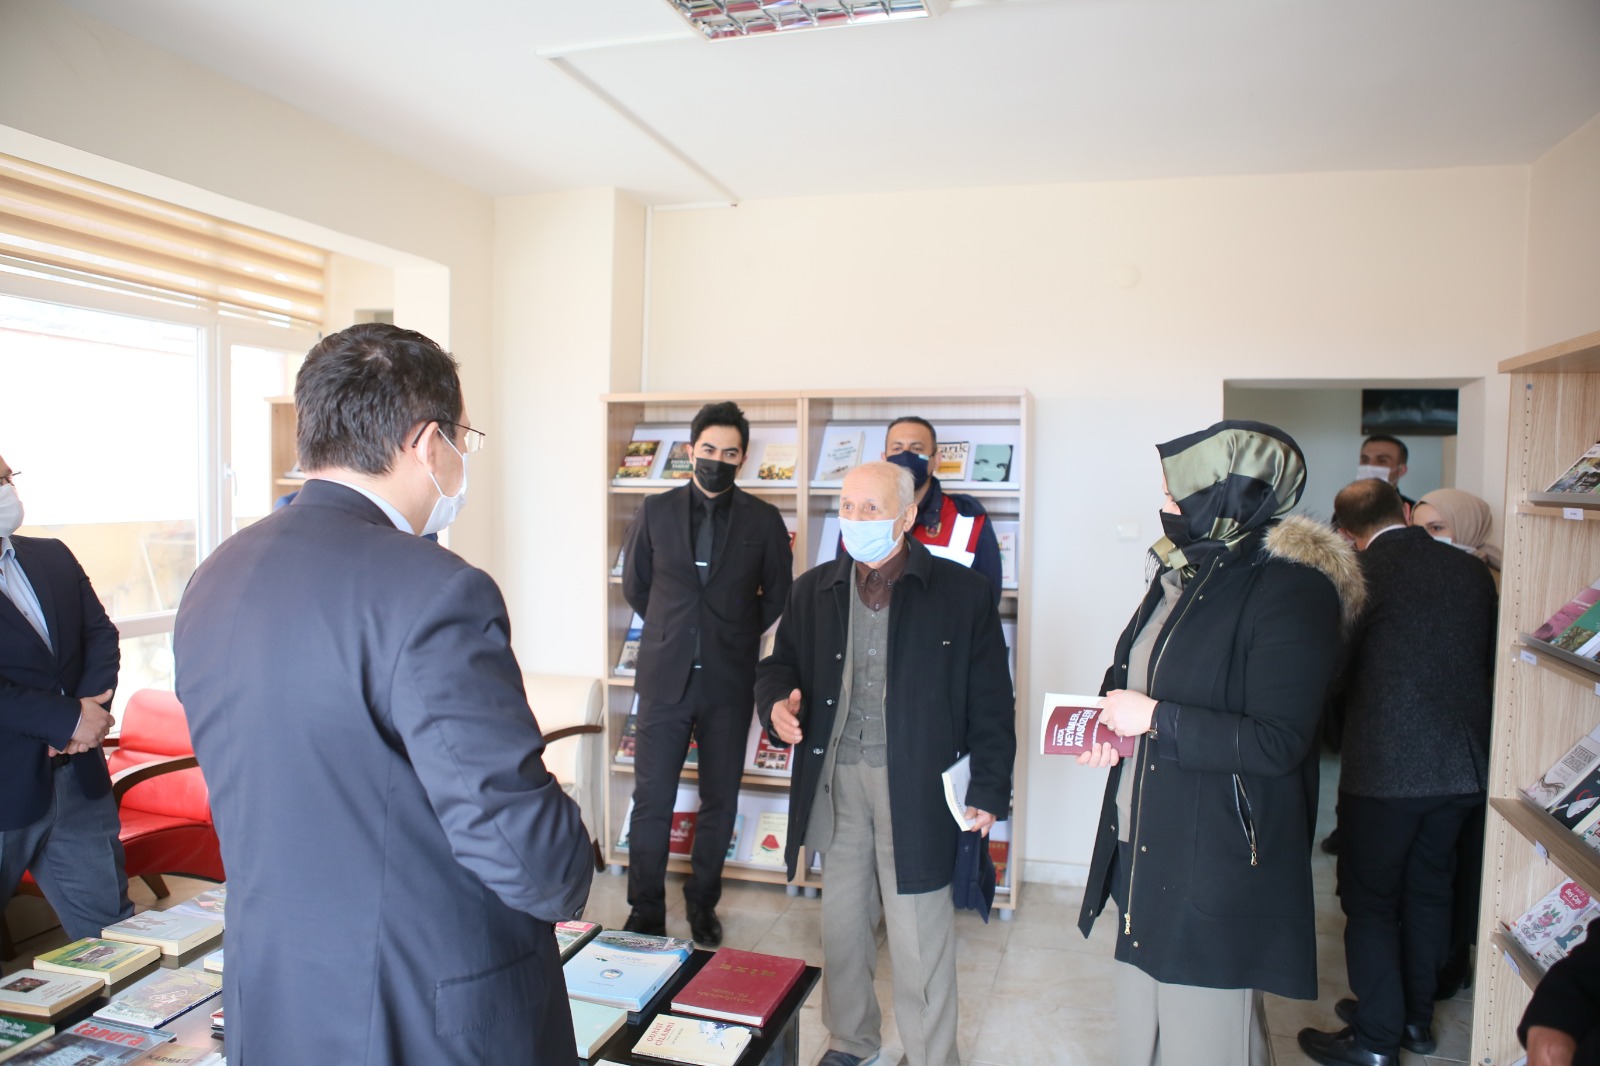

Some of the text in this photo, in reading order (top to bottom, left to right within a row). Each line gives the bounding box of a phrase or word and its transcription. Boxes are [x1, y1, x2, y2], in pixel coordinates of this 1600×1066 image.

[1057, 728, 1065, 746] LAZCA
[1064, 712, 1079, 747] DEYİMLER
[1074, 709, 1090, 748] ATASÖZLERİ
[1564, 755, 1586, 772] ZWEIG
[1572, 746, 1594, 764] STEFAN
[73, 1022, 146, 1047] tanura
[145, 1054, 194, 1065] KARMATE
